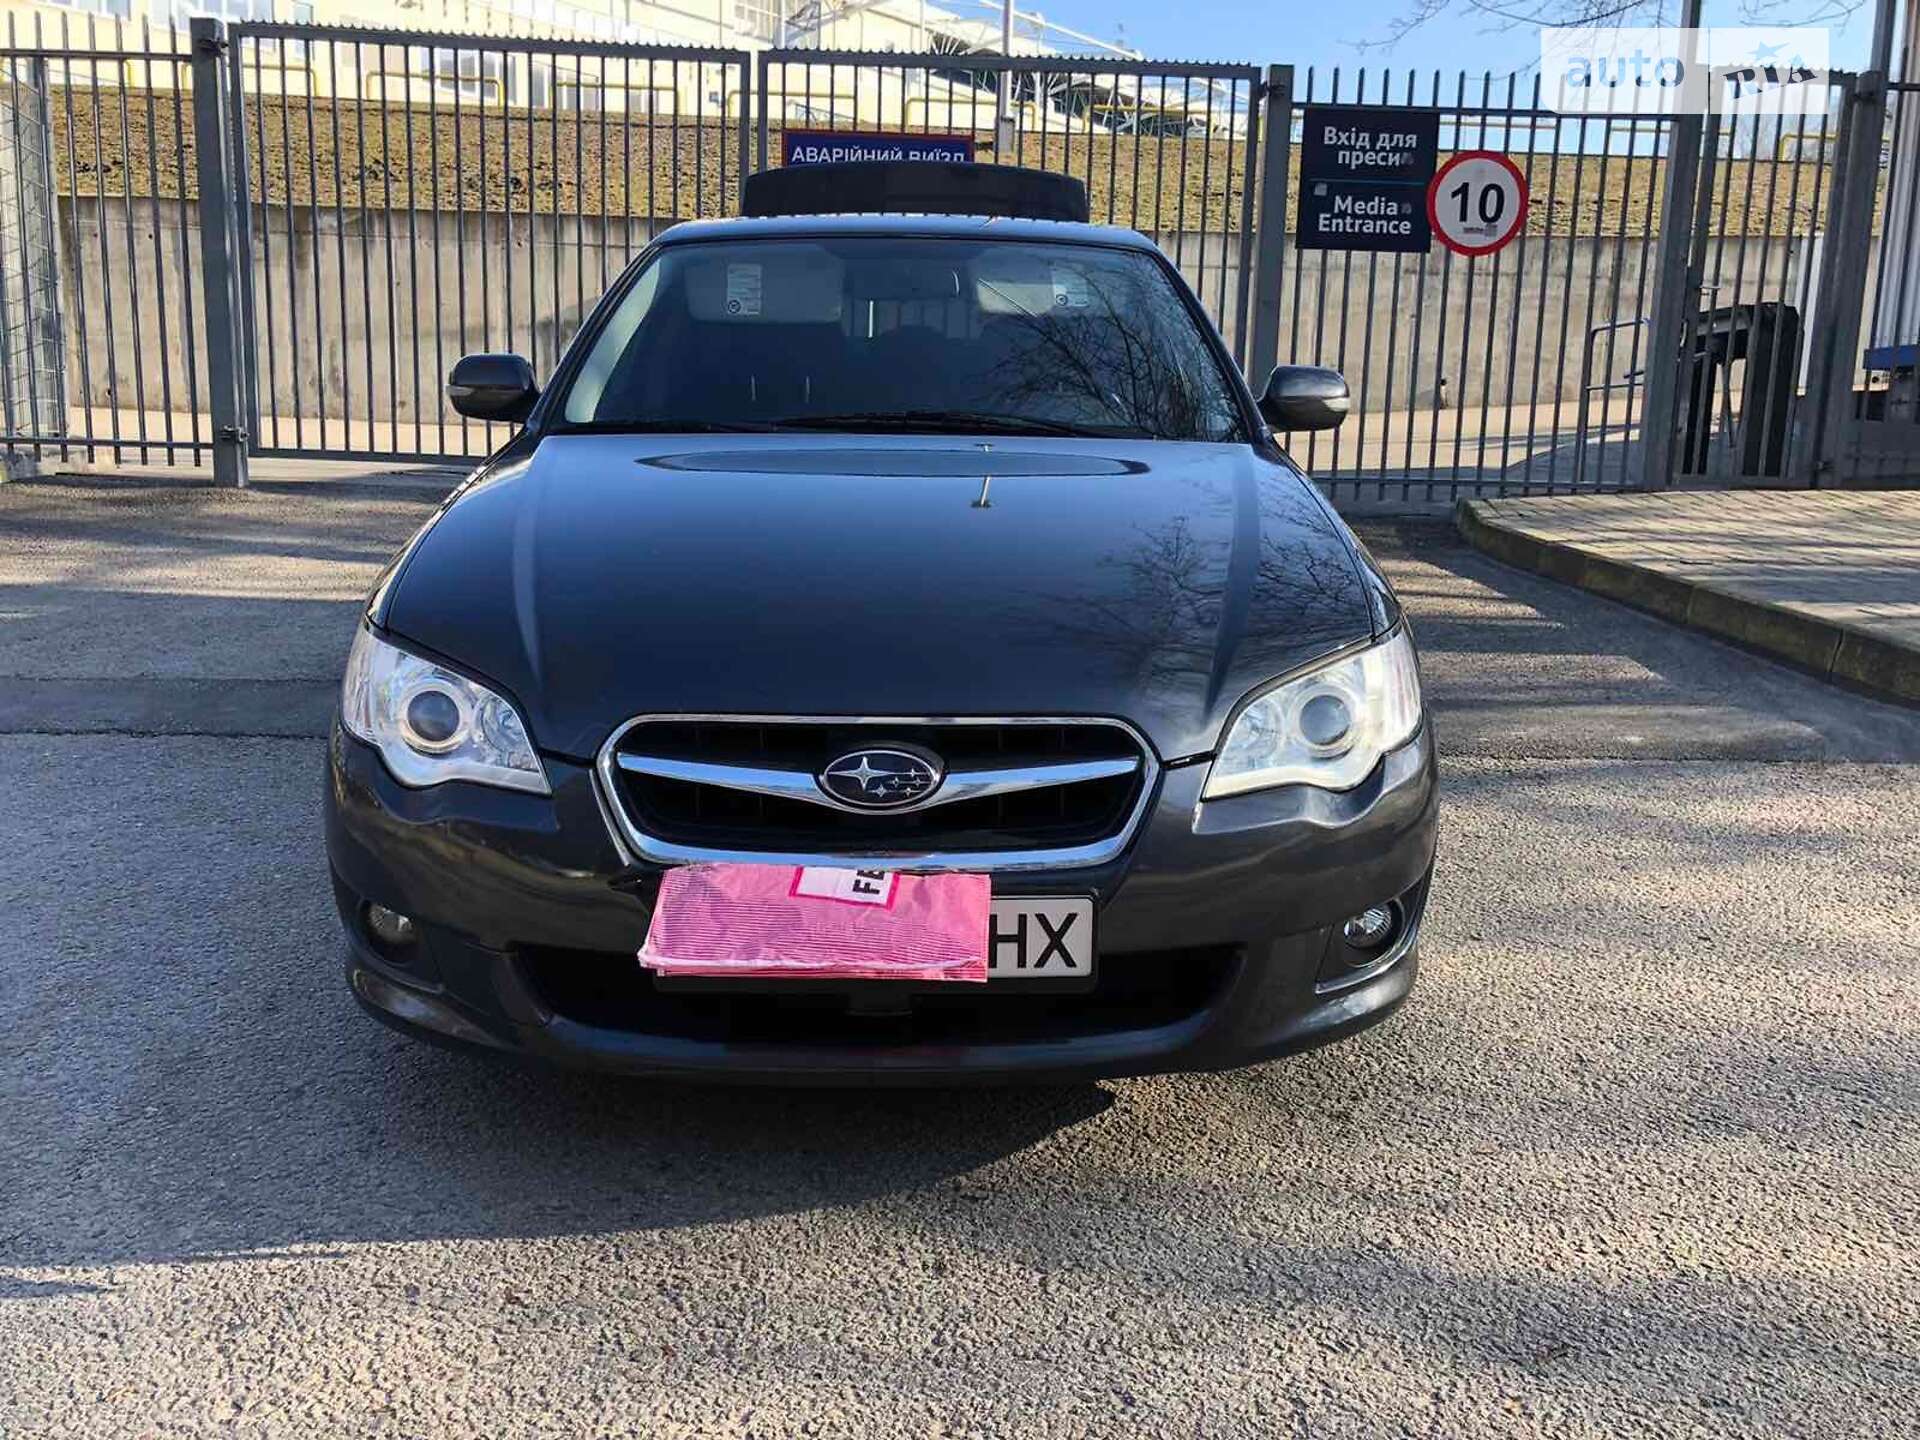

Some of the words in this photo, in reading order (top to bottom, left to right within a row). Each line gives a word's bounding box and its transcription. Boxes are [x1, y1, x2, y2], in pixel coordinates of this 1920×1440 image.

[1323, 127, 1370, 149] Вхід
[1376, 133, 1418, 150] для
[791, 145, 903, 162] АВАРІЙНИЙ
[1333, 195, 1399, 216] Media
[1450, 182, 1506, 224] 10
[1318, 214, 1413, 235] Entrance
[988, 912, 1078, 969] HX
